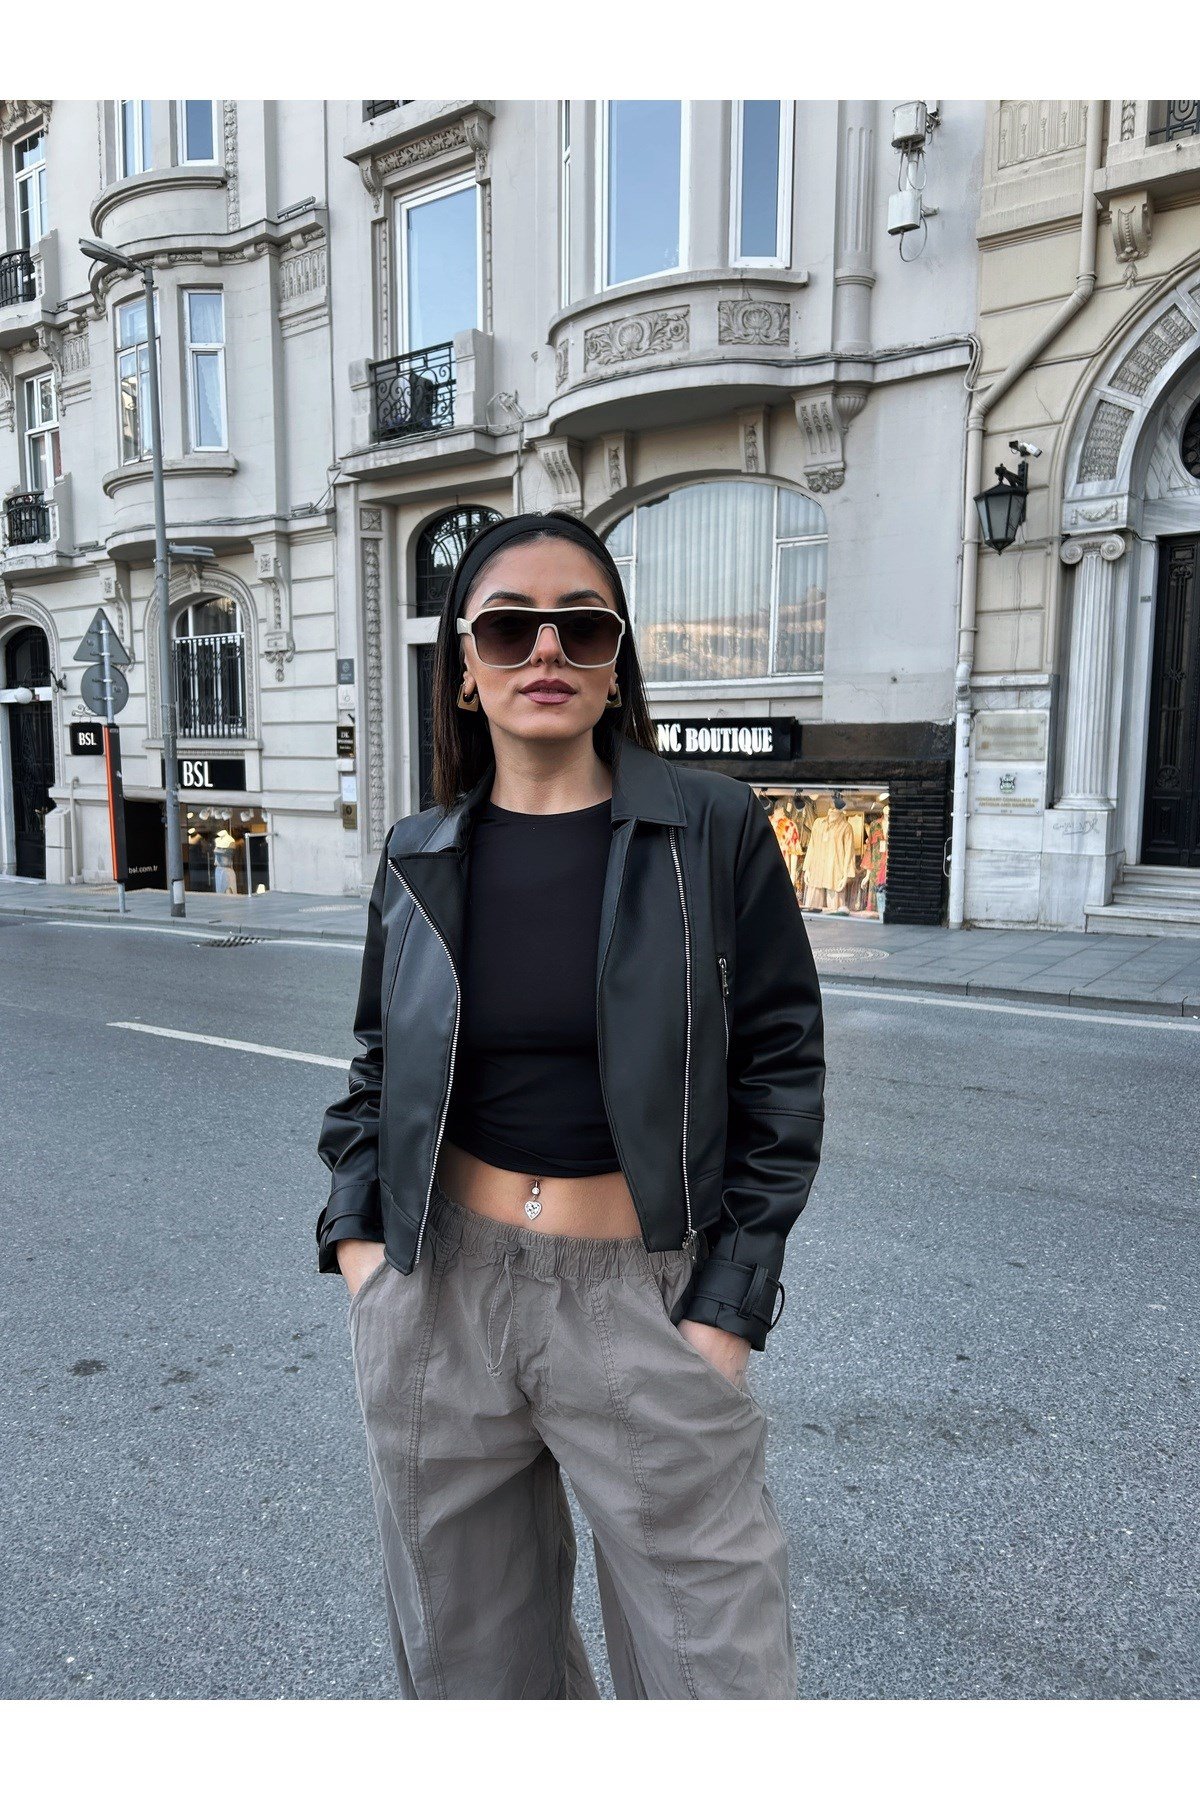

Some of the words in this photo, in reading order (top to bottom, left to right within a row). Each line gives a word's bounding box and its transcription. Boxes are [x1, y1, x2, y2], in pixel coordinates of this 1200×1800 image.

[78, 732, 97, 746] BSL
[685, 727, 773, 755] BOUTIQUE
[182, 760, 214, 788] BSL
